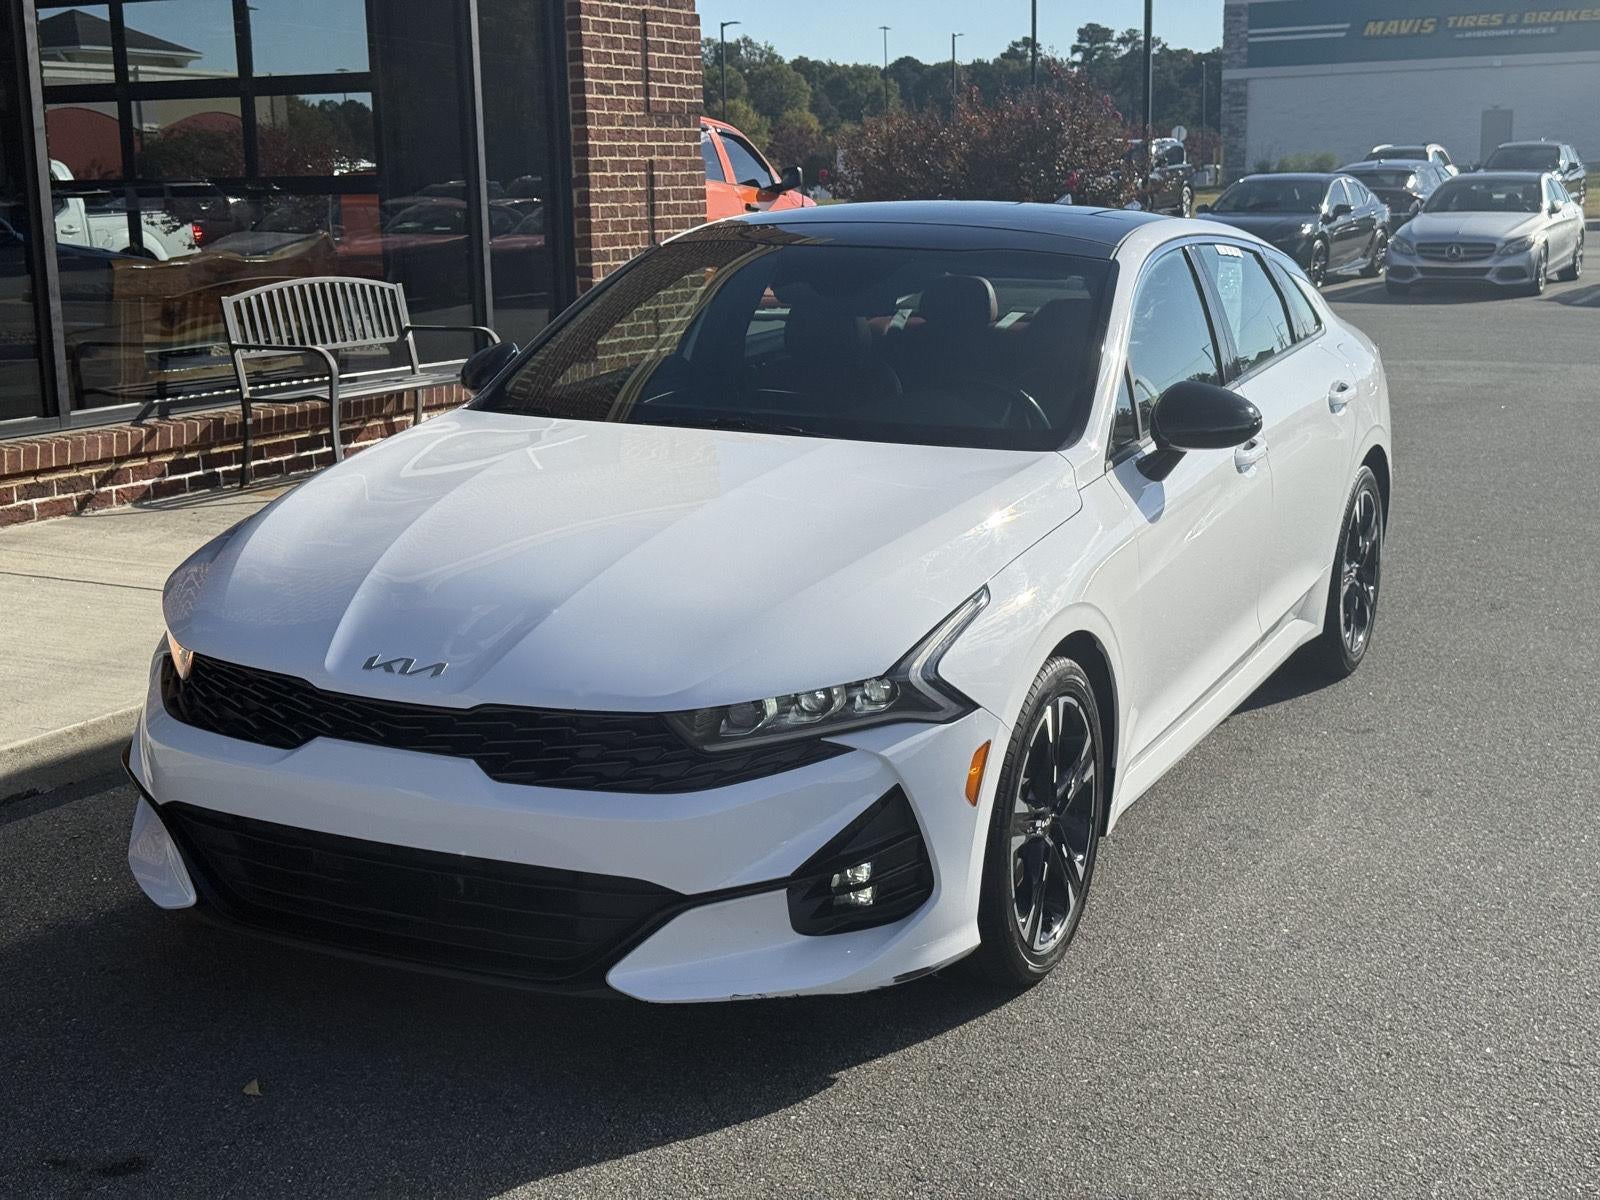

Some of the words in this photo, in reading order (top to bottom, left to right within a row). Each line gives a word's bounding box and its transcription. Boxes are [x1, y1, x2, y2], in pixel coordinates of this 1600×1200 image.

[1363, 18, 1438, 37] MAVIS
[1447, 14, 1504, 28] TIRES
[1523, 8, 1600, 24] BRAKES
[362, 653, 449, 678] KIA
